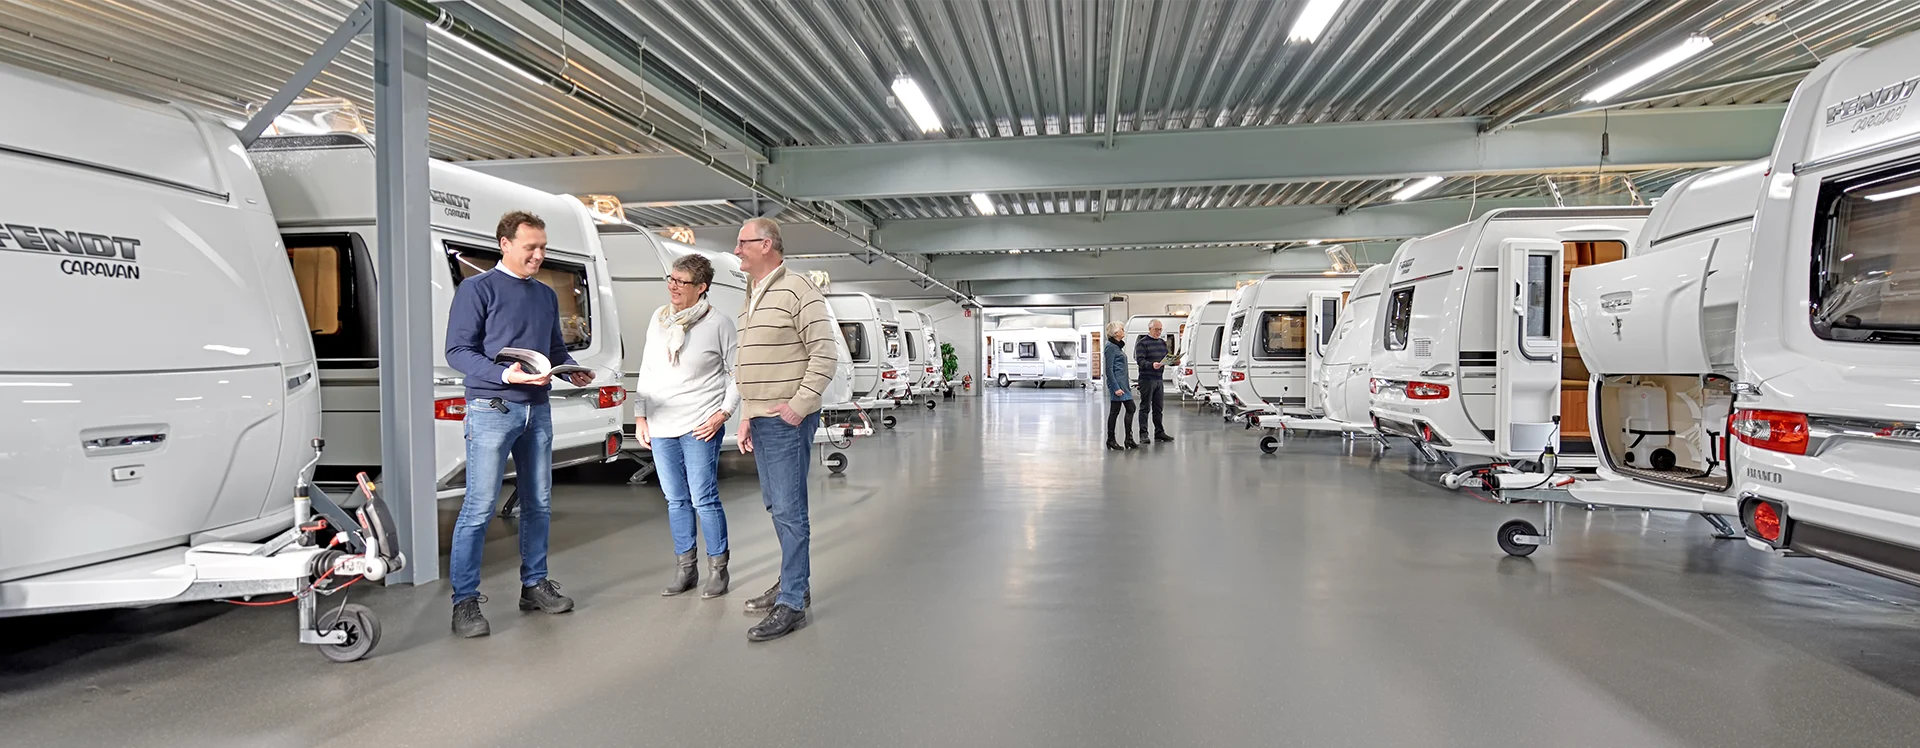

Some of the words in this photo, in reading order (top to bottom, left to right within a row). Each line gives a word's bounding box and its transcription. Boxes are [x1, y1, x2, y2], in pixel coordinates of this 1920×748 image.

[429, 189, 471, 210] ENDT
[60, 259, 140, 279] CARAVAN
[1746, 467, 1782, 484] BIANCO
